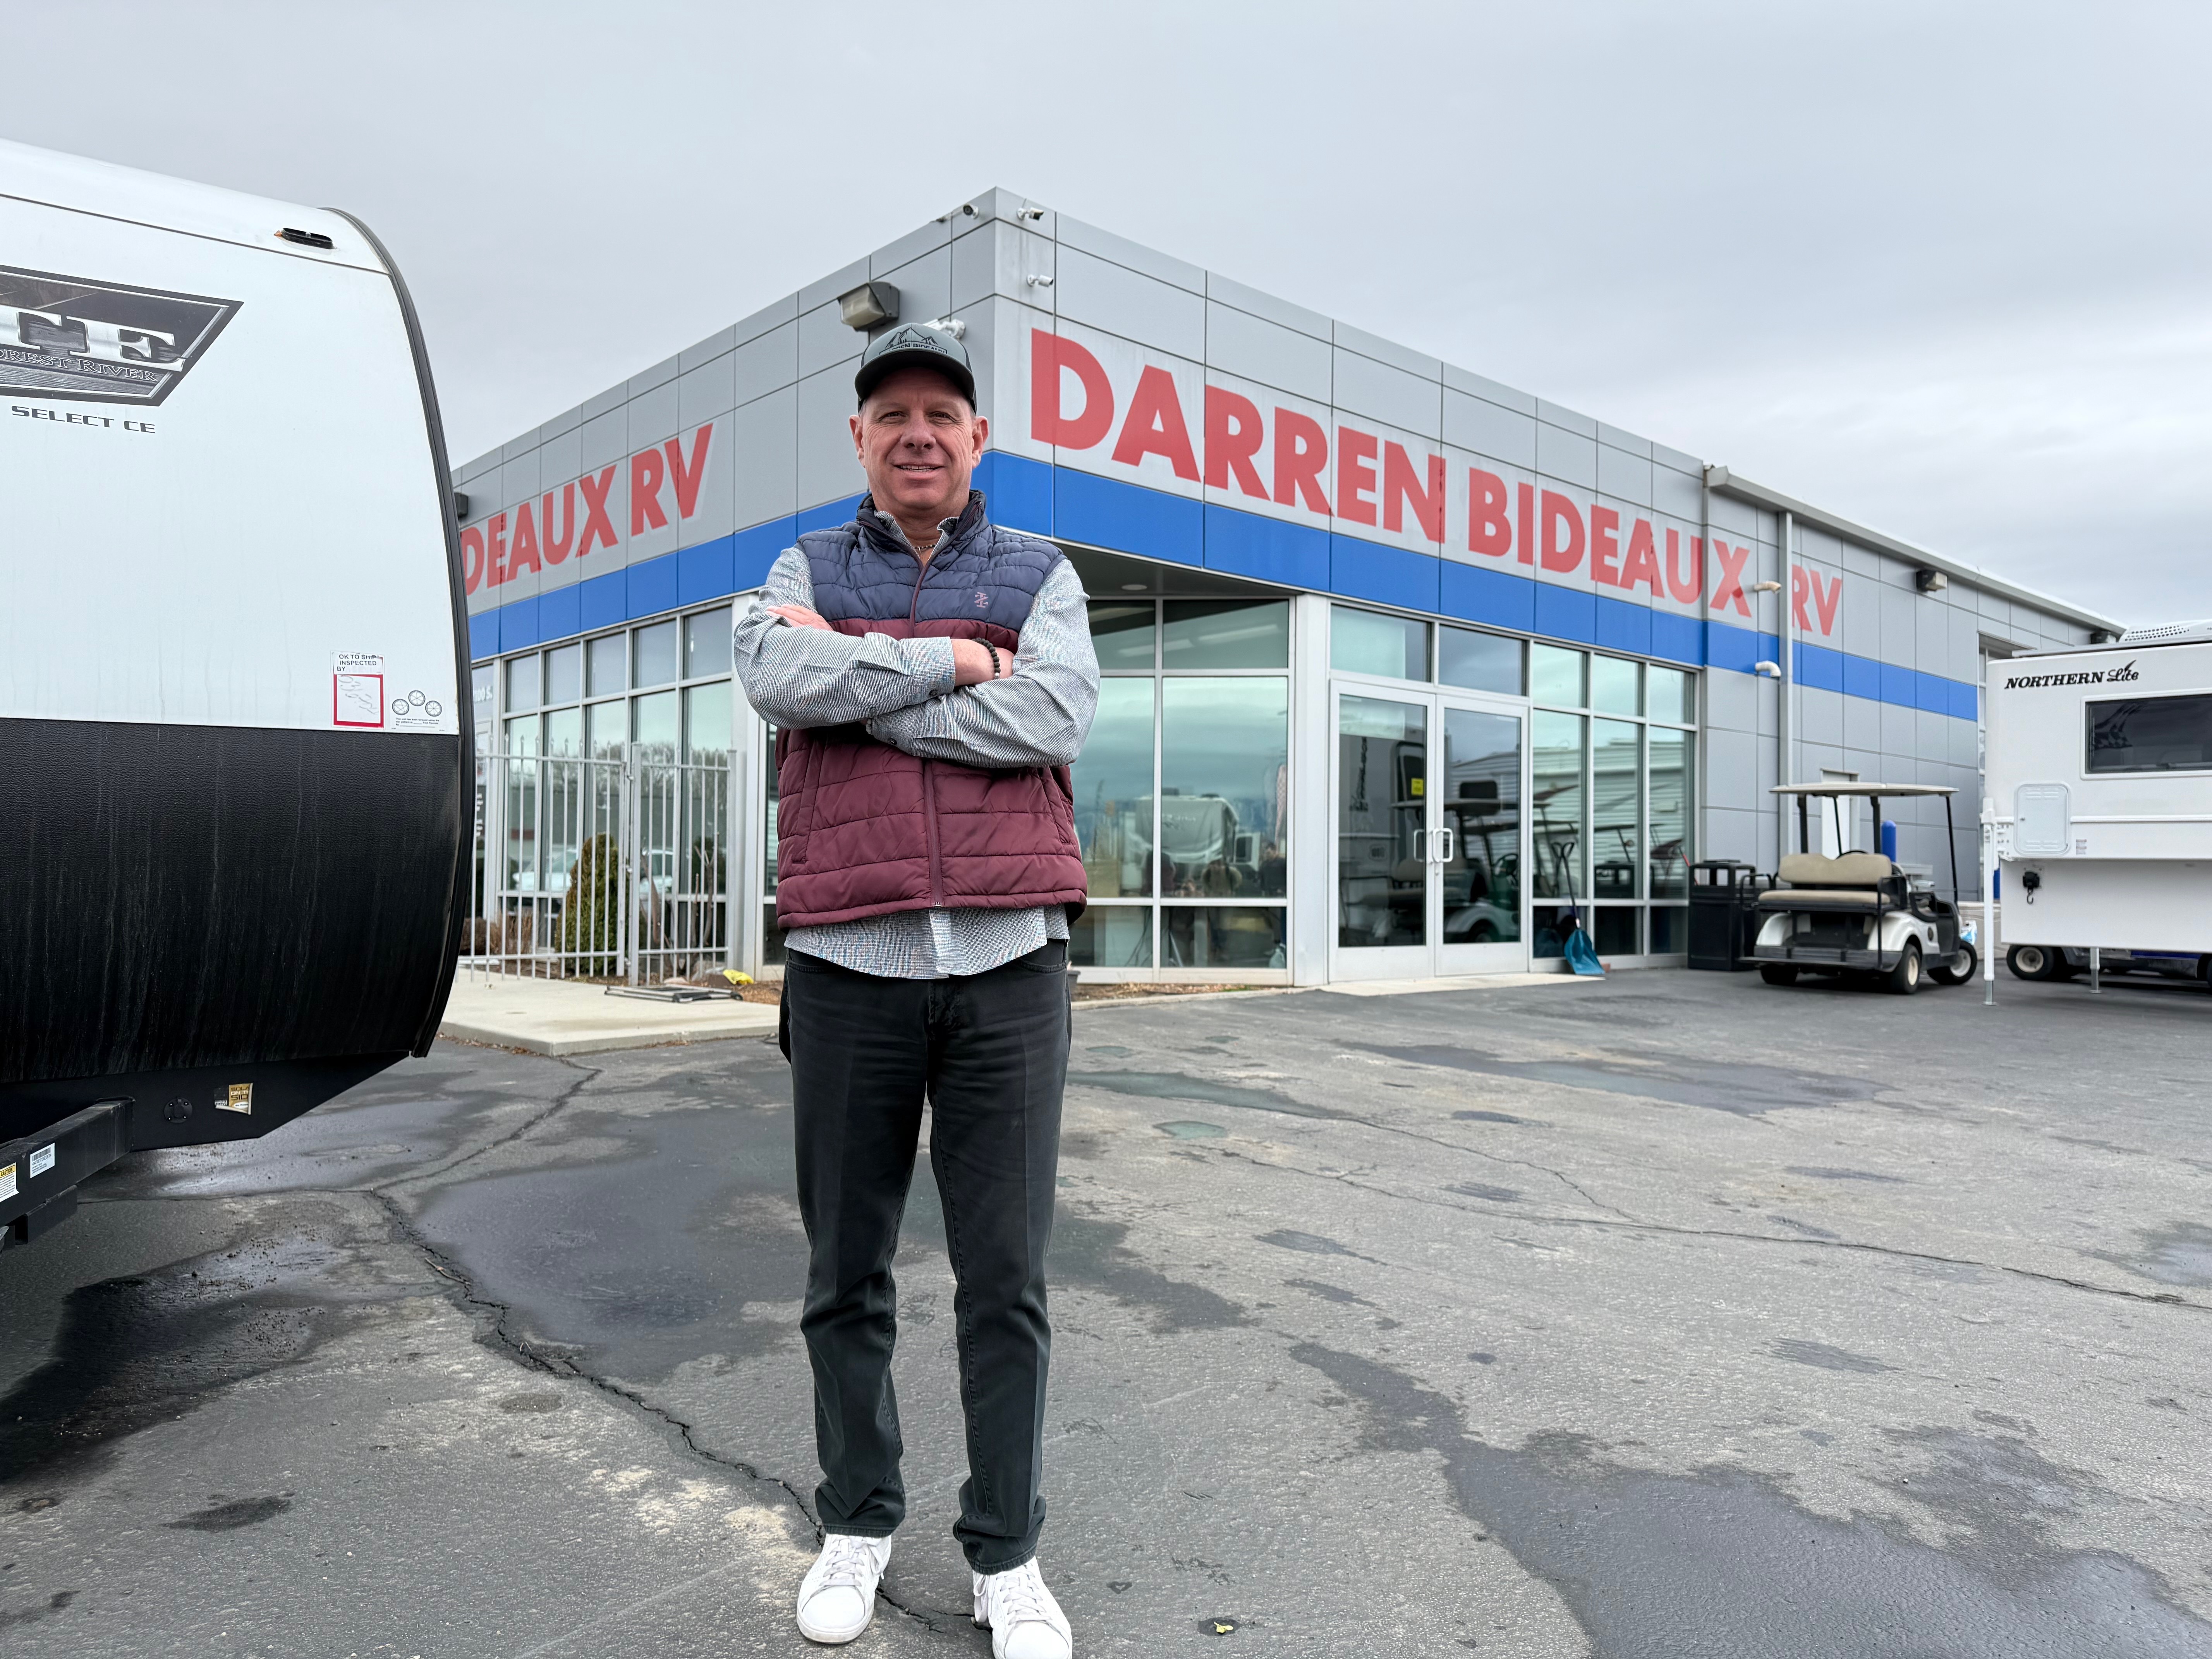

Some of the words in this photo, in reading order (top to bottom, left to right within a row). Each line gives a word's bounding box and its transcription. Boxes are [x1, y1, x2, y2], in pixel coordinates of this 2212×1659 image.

[77, 359, 158, 381] RIVER
[12, 406, 114, 428] SELECT
[124, 421, 155, 433] CE
[1031, 328, 1445, 544] DARREN
[1468, 467, 1752, 617] BIDEAUX
[1792, 565, 1842, 636] RV
[460, 465, 618, 596] DEAUX
[631, 423, 713, 537] RV
[2004, 671, 2106, 689] NORTHERN
[2106, 659, 2139, 682] Lite
